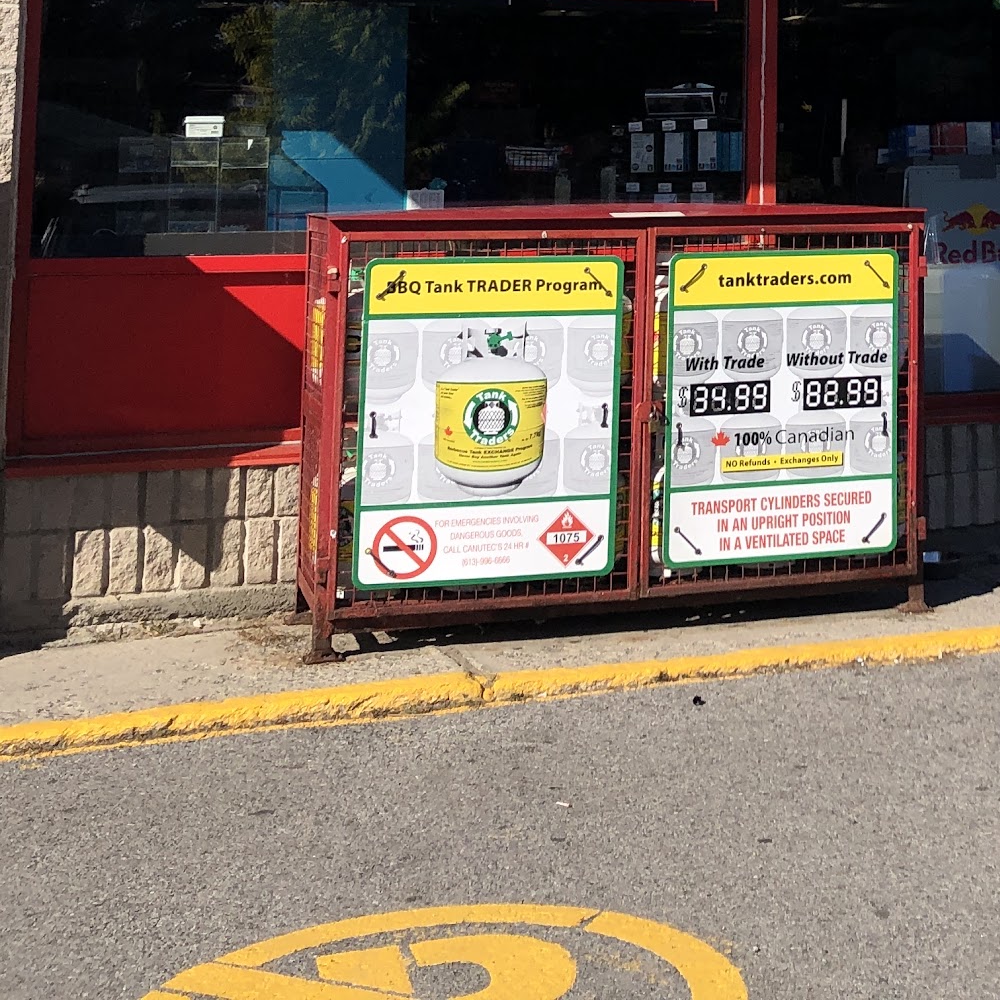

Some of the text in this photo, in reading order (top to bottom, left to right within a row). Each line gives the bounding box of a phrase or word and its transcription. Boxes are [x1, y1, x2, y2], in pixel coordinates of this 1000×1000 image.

[933, 240, 977, 265] Red
[425, 280, 463, 293] Tank
[467, 279, 532, 293] TRADER
[535, 278, 602, 296] Program
[717, 271, 852, 288] tanktraders.com
[685, 353, 765, 371] With Trade
[786, 348, 888, 367] Without Trade
[476, 390, 507, 401] Tank
[469, 428, 516, 447] Traders
[733, 426, 855, 447] 100% Canadian
[725, 453, 839, 468] NO Refunds Exchanges Only
[691, 490, 872, 516] TRANSPORT CYLINDERS SECURED
[434, 514, 540, 528] FOR EMERGENCIES INVOLVING
[717, 510, 851, 533] IN AN UPRIGHT POSITION
[450, 530, 495, 540] DANGEROUS
[553, 533, 580, 544] 1075
[719, 529, 846, 551] IN A VENTILATED SPACE
[443, 541, 530, 554] CALL CANUTEC'S 24 HR #
[563, 553, 569, 563] 2
